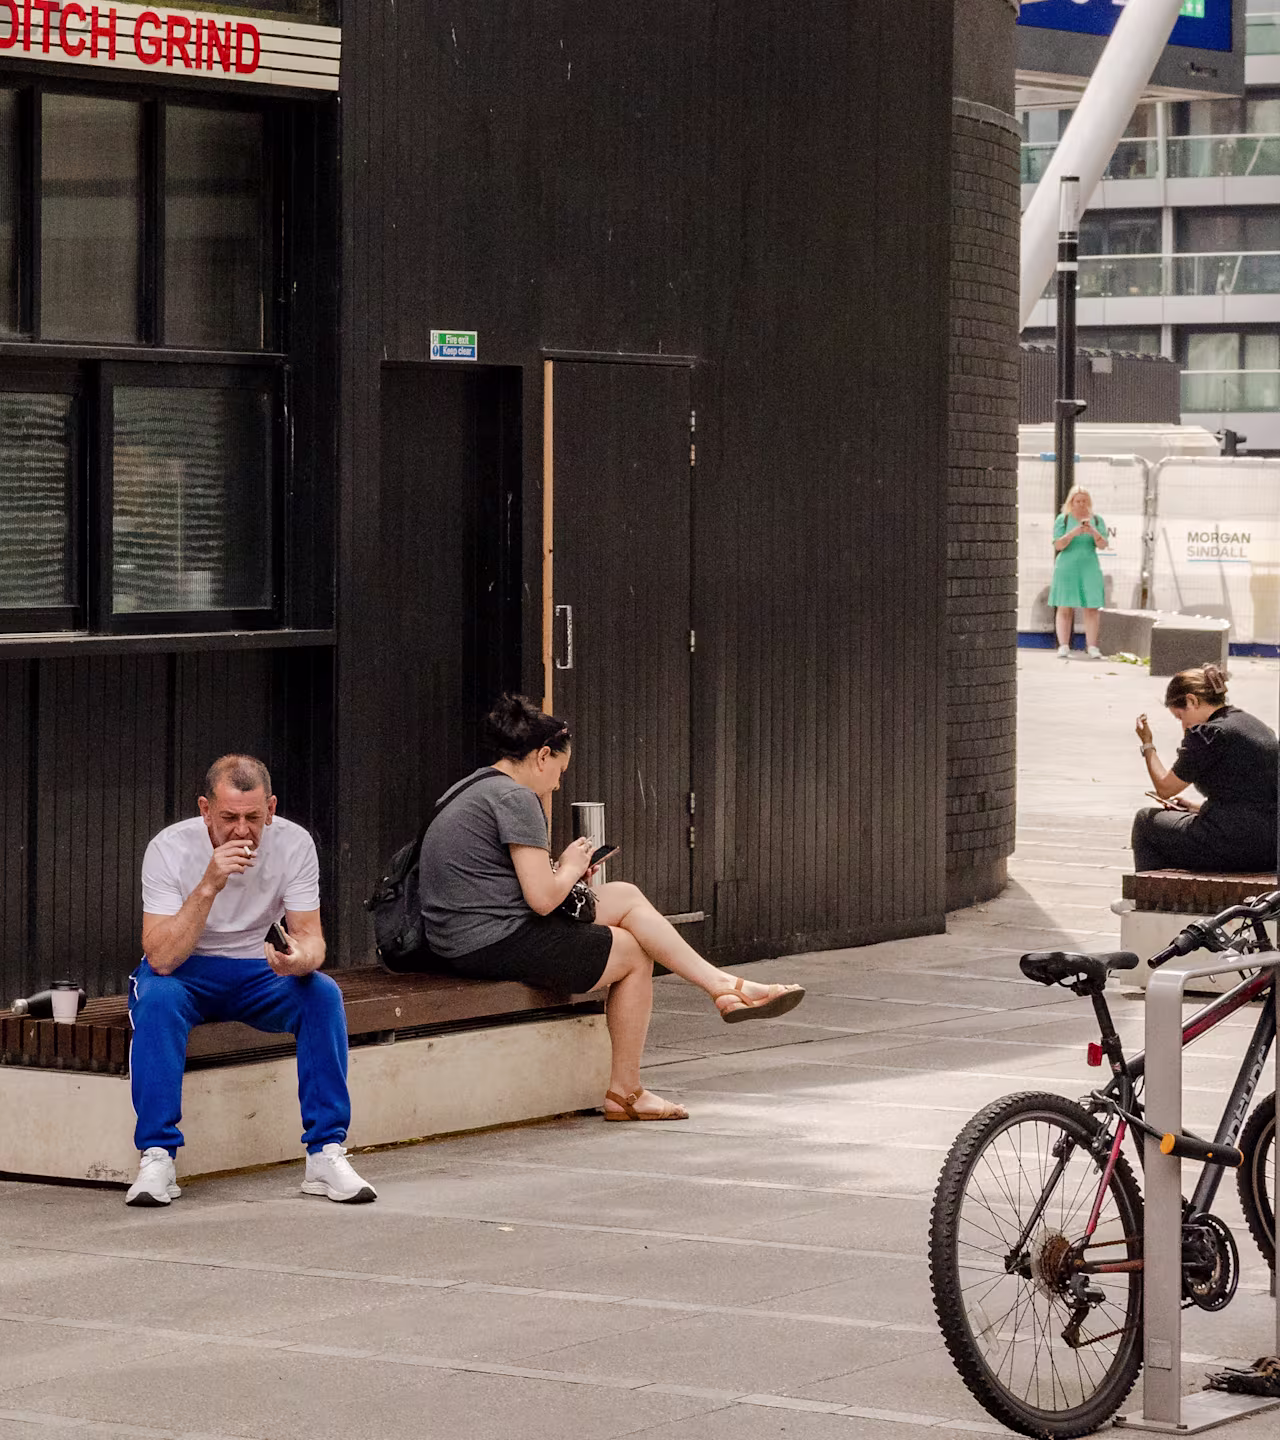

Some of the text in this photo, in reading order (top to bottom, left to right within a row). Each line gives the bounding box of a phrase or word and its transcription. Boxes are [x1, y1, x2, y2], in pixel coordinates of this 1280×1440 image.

[134, 11, 261, 75] GRIND
[446, 334, 469, 344] Fire exit
[1187, 531, 1251, 544] MORGAN
[1186, 545, 1248, 558] SINDALL
